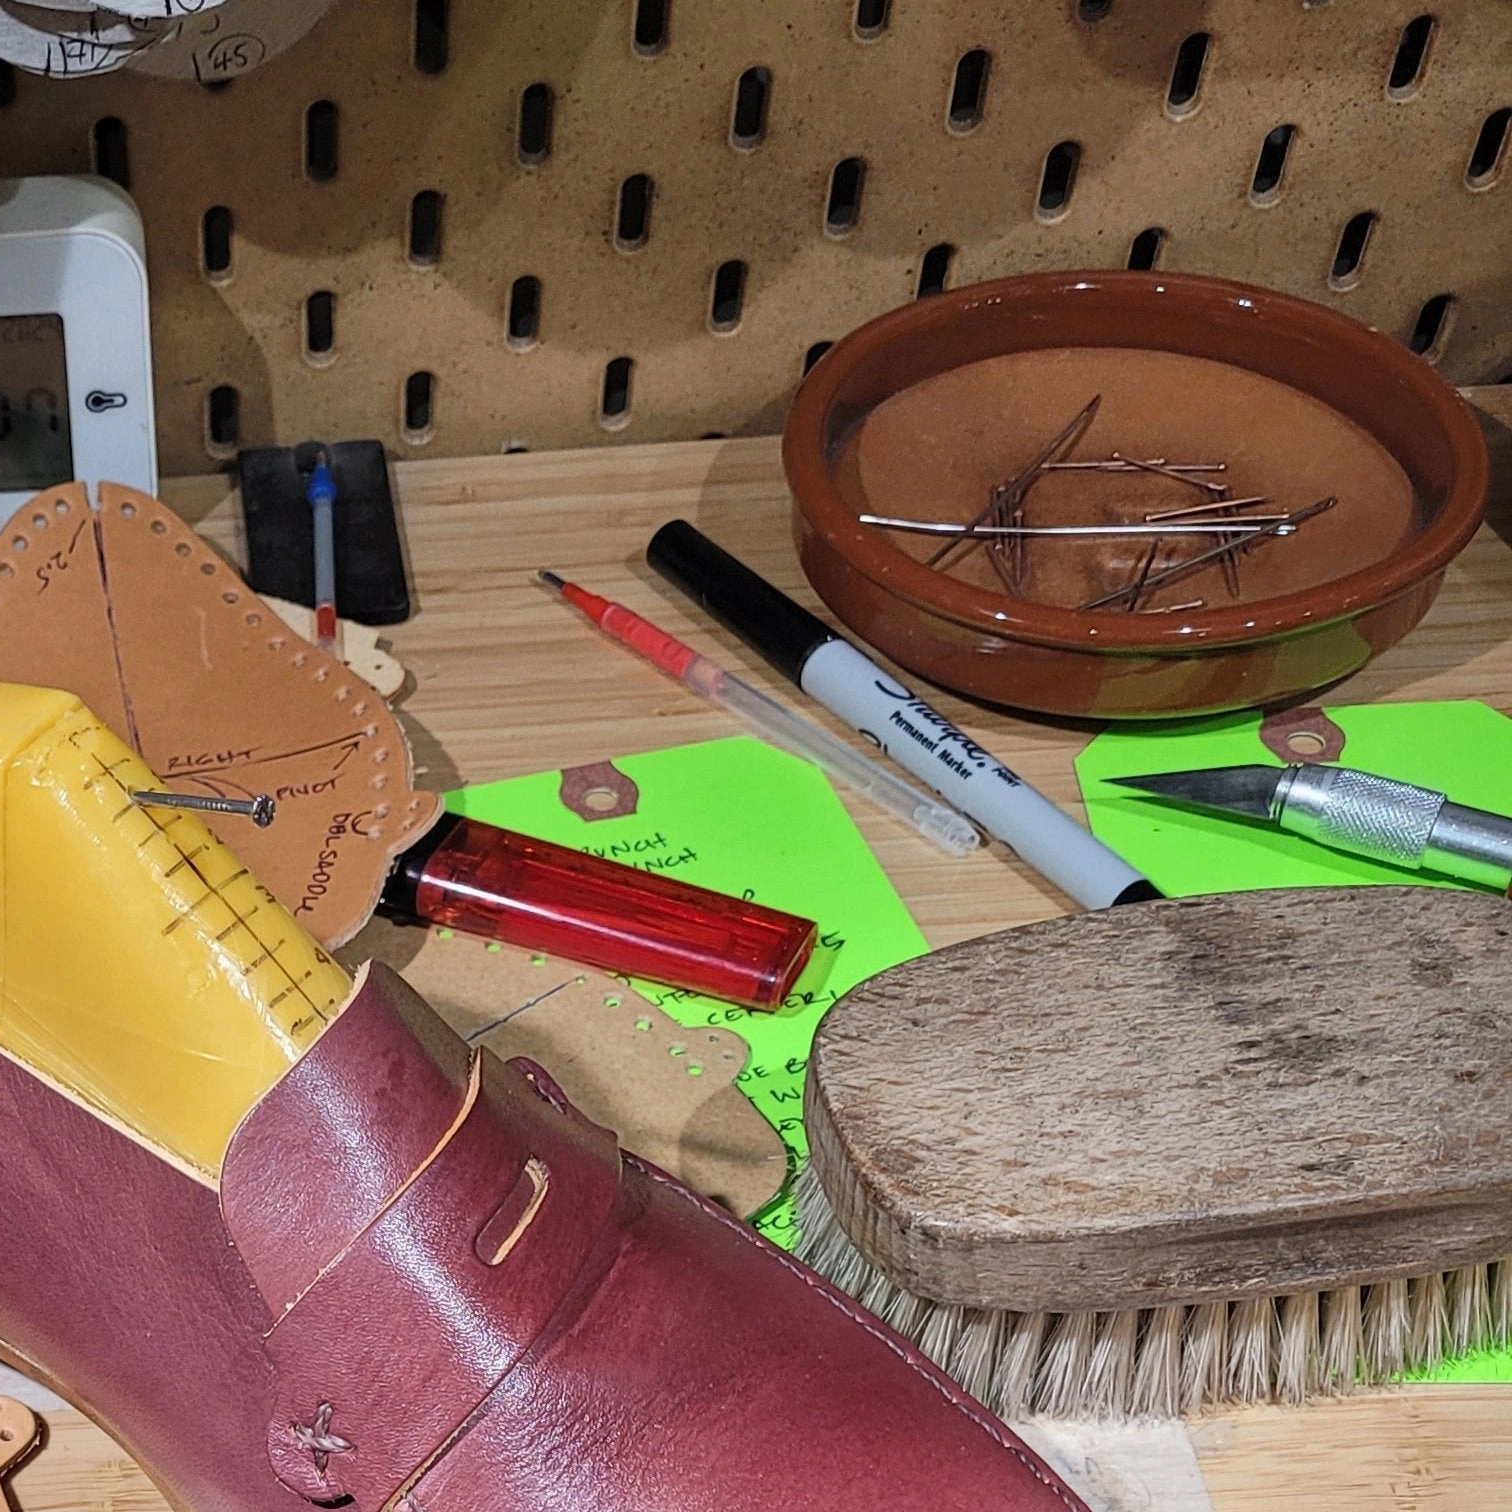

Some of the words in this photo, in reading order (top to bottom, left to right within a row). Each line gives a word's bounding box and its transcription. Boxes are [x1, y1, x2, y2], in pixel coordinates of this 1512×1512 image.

[37, 551, 69, 596] 2.5
[168, 747, 256, 771] RIGHT
[889, 710, 939, 754] Permanent
[938, 748, 973, 780] Marker
[276, 775, 341, 800] PIVOT
[325, 812, 352, 848] DBL
